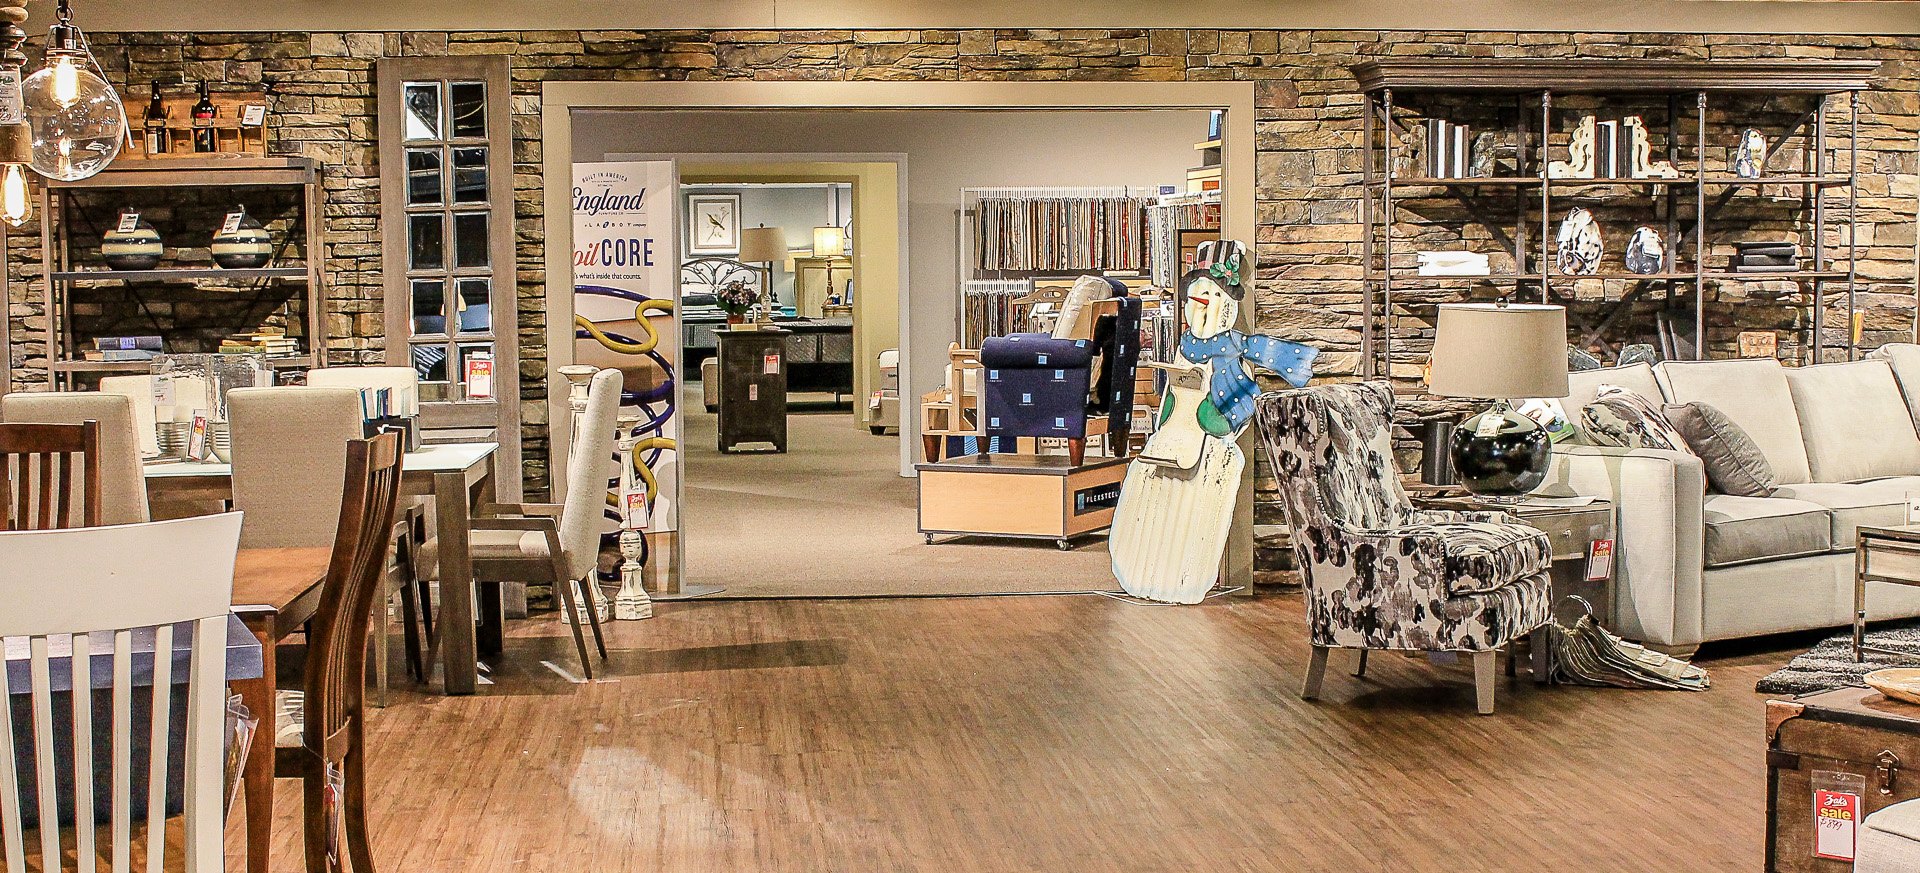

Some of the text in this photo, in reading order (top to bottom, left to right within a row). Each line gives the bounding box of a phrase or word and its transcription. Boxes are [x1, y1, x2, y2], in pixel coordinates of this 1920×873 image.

[582, 173, 596, 183] BUILT
[605, 172, 628, 182] AMERICA
[573, 187, 646, 216] England
[579, 272, 596, 280] what's
[596, 272, 611, 280] inside
[611, 272, 623, 280] that
[1086, 491, 1119, 503] FLEXSTEEL
[1823, 794, 1848, 807] Zak's
[1820, 807, 1852, 820] sale
